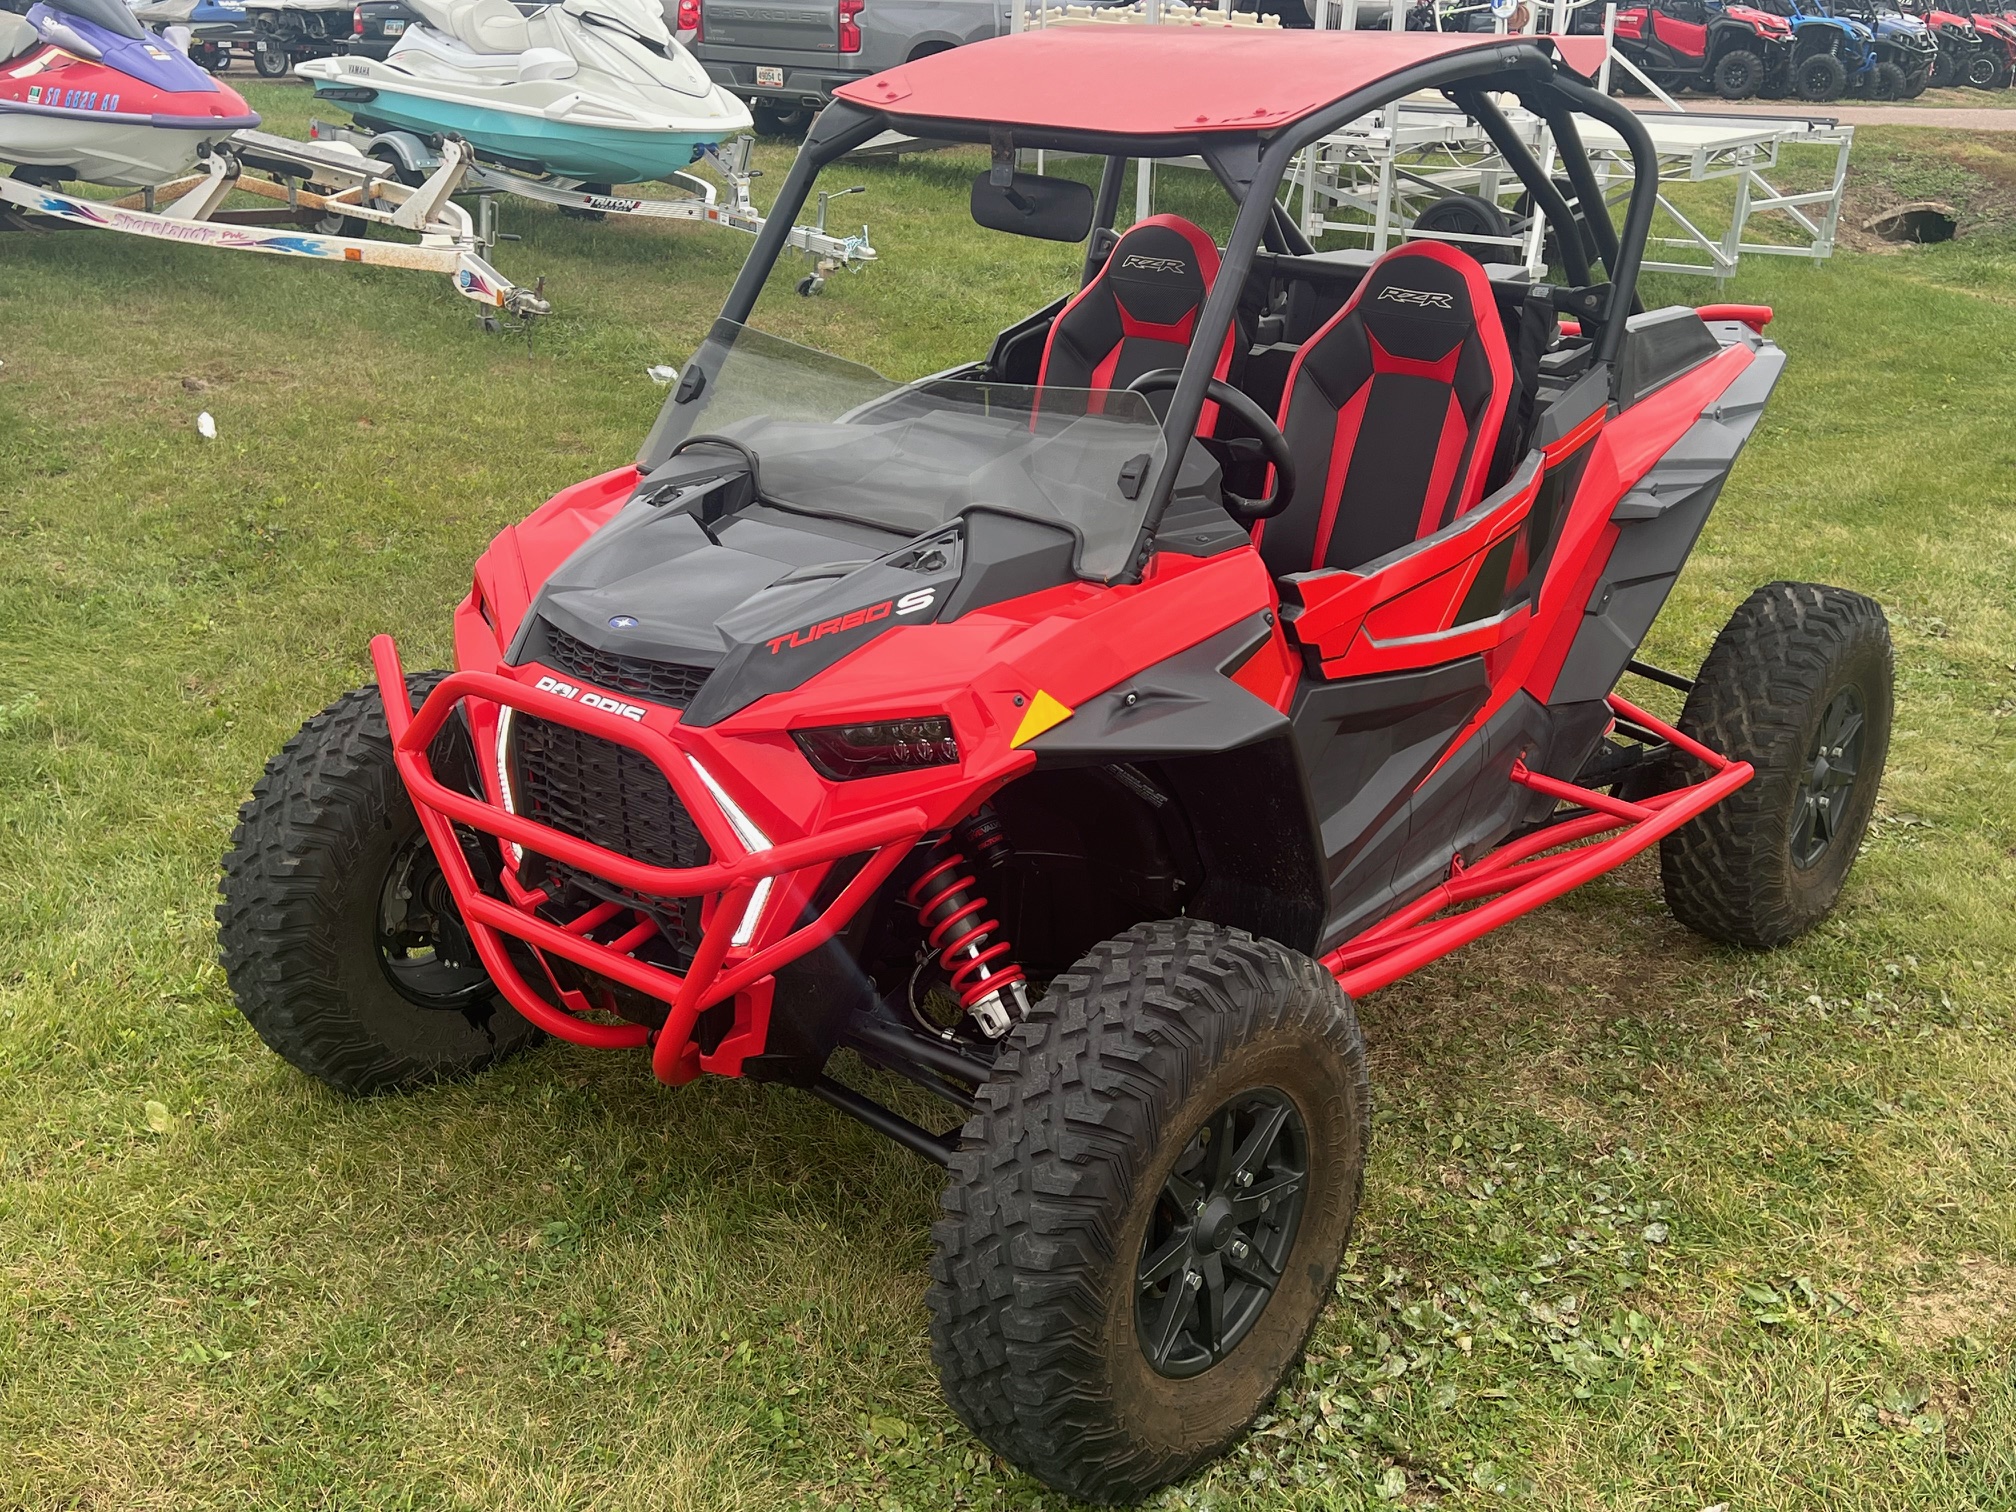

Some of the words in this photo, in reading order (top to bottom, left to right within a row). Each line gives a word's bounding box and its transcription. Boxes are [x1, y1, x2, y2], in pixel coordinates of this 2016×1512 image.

[708, 6, 827, 22] CHEVROLET
[348, 64, 370, 76] YAMAHA
[65, 89, 98, 110] 6828
[1122, 254, 1186, 275] RZR
[1377, 286, 1454, 309] RZR
[766, 600, 893, 655] TURBO
[895, 587, 936, 616] S
[1317, 1094, 1348, 1241] COYOTE
